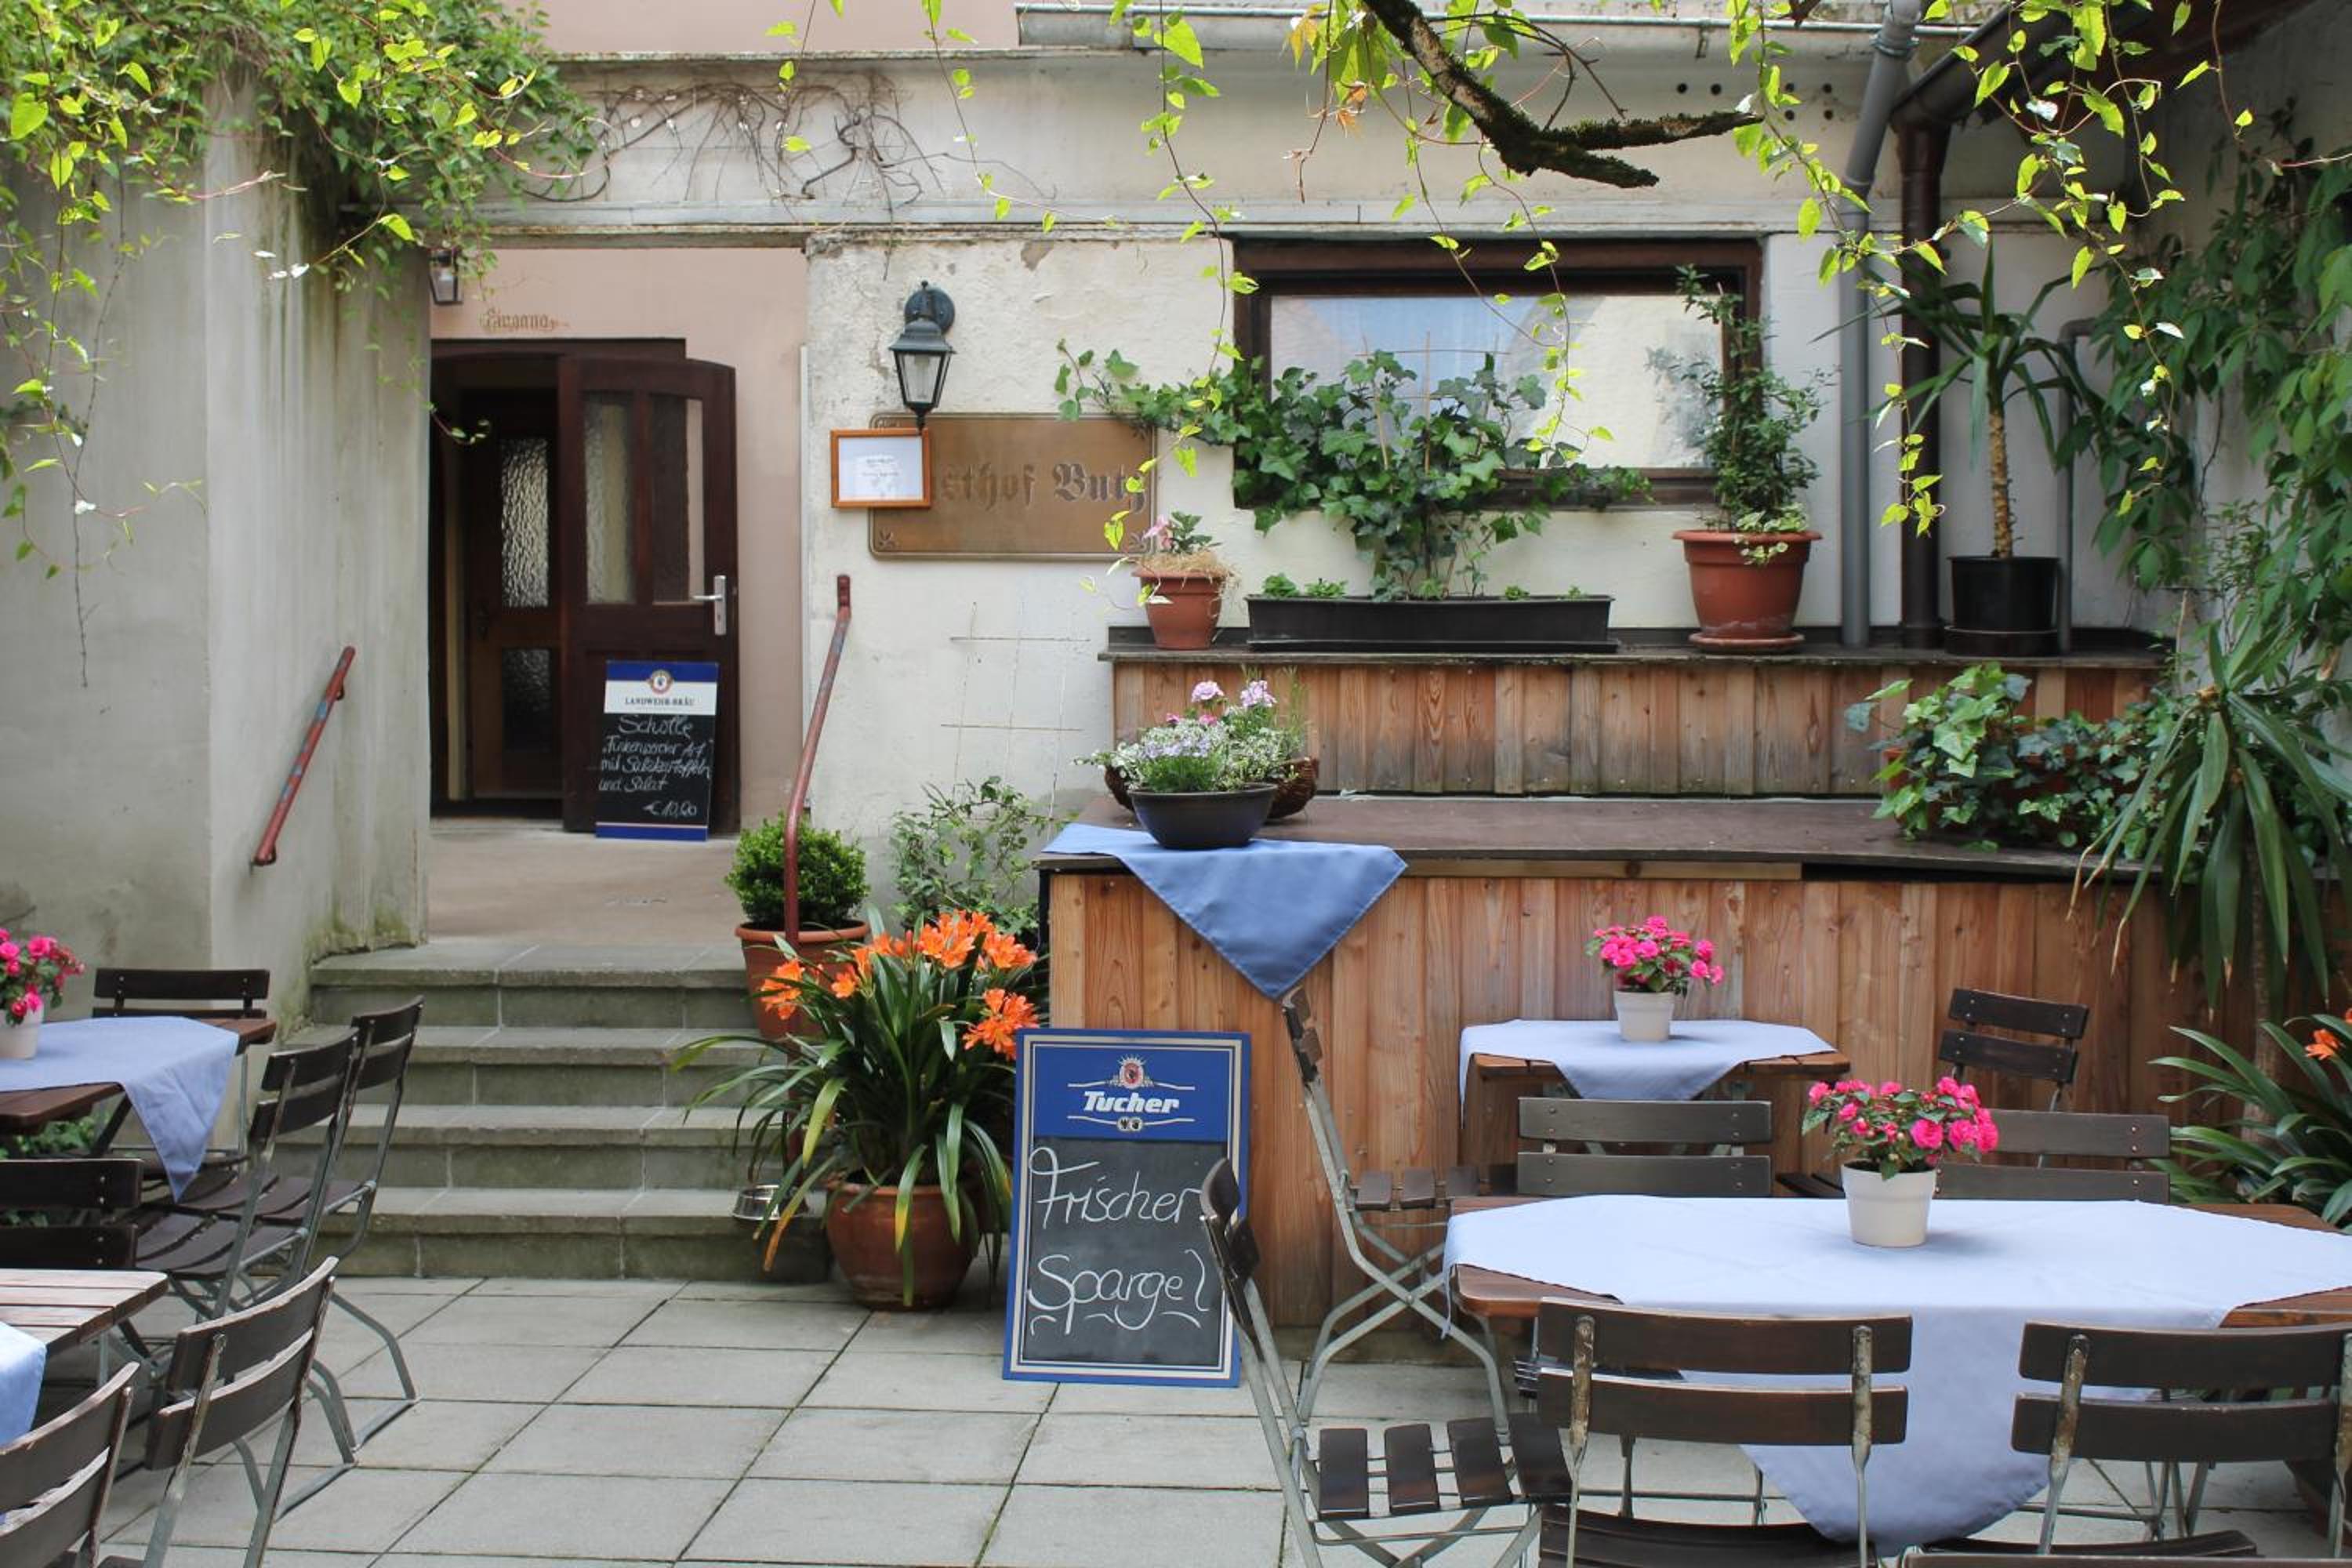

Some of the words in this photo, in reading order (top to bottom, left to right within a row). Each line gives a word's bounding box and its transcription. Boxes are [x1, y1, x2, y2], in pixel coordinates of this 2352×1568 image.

[942, 461, 1036, 513] sthof
[619, 714, 693, 739] Scholle
[601, 754, 621, 771] mit
[598, 779, 622, 792] und
[624, 776, 670, 793] Salat
[1083, 1091, 1180, 1113] Tucher
[1029, 1147, 1203, 1229] Frischer
[1027, 1249, 1209, 1334] Spargel
